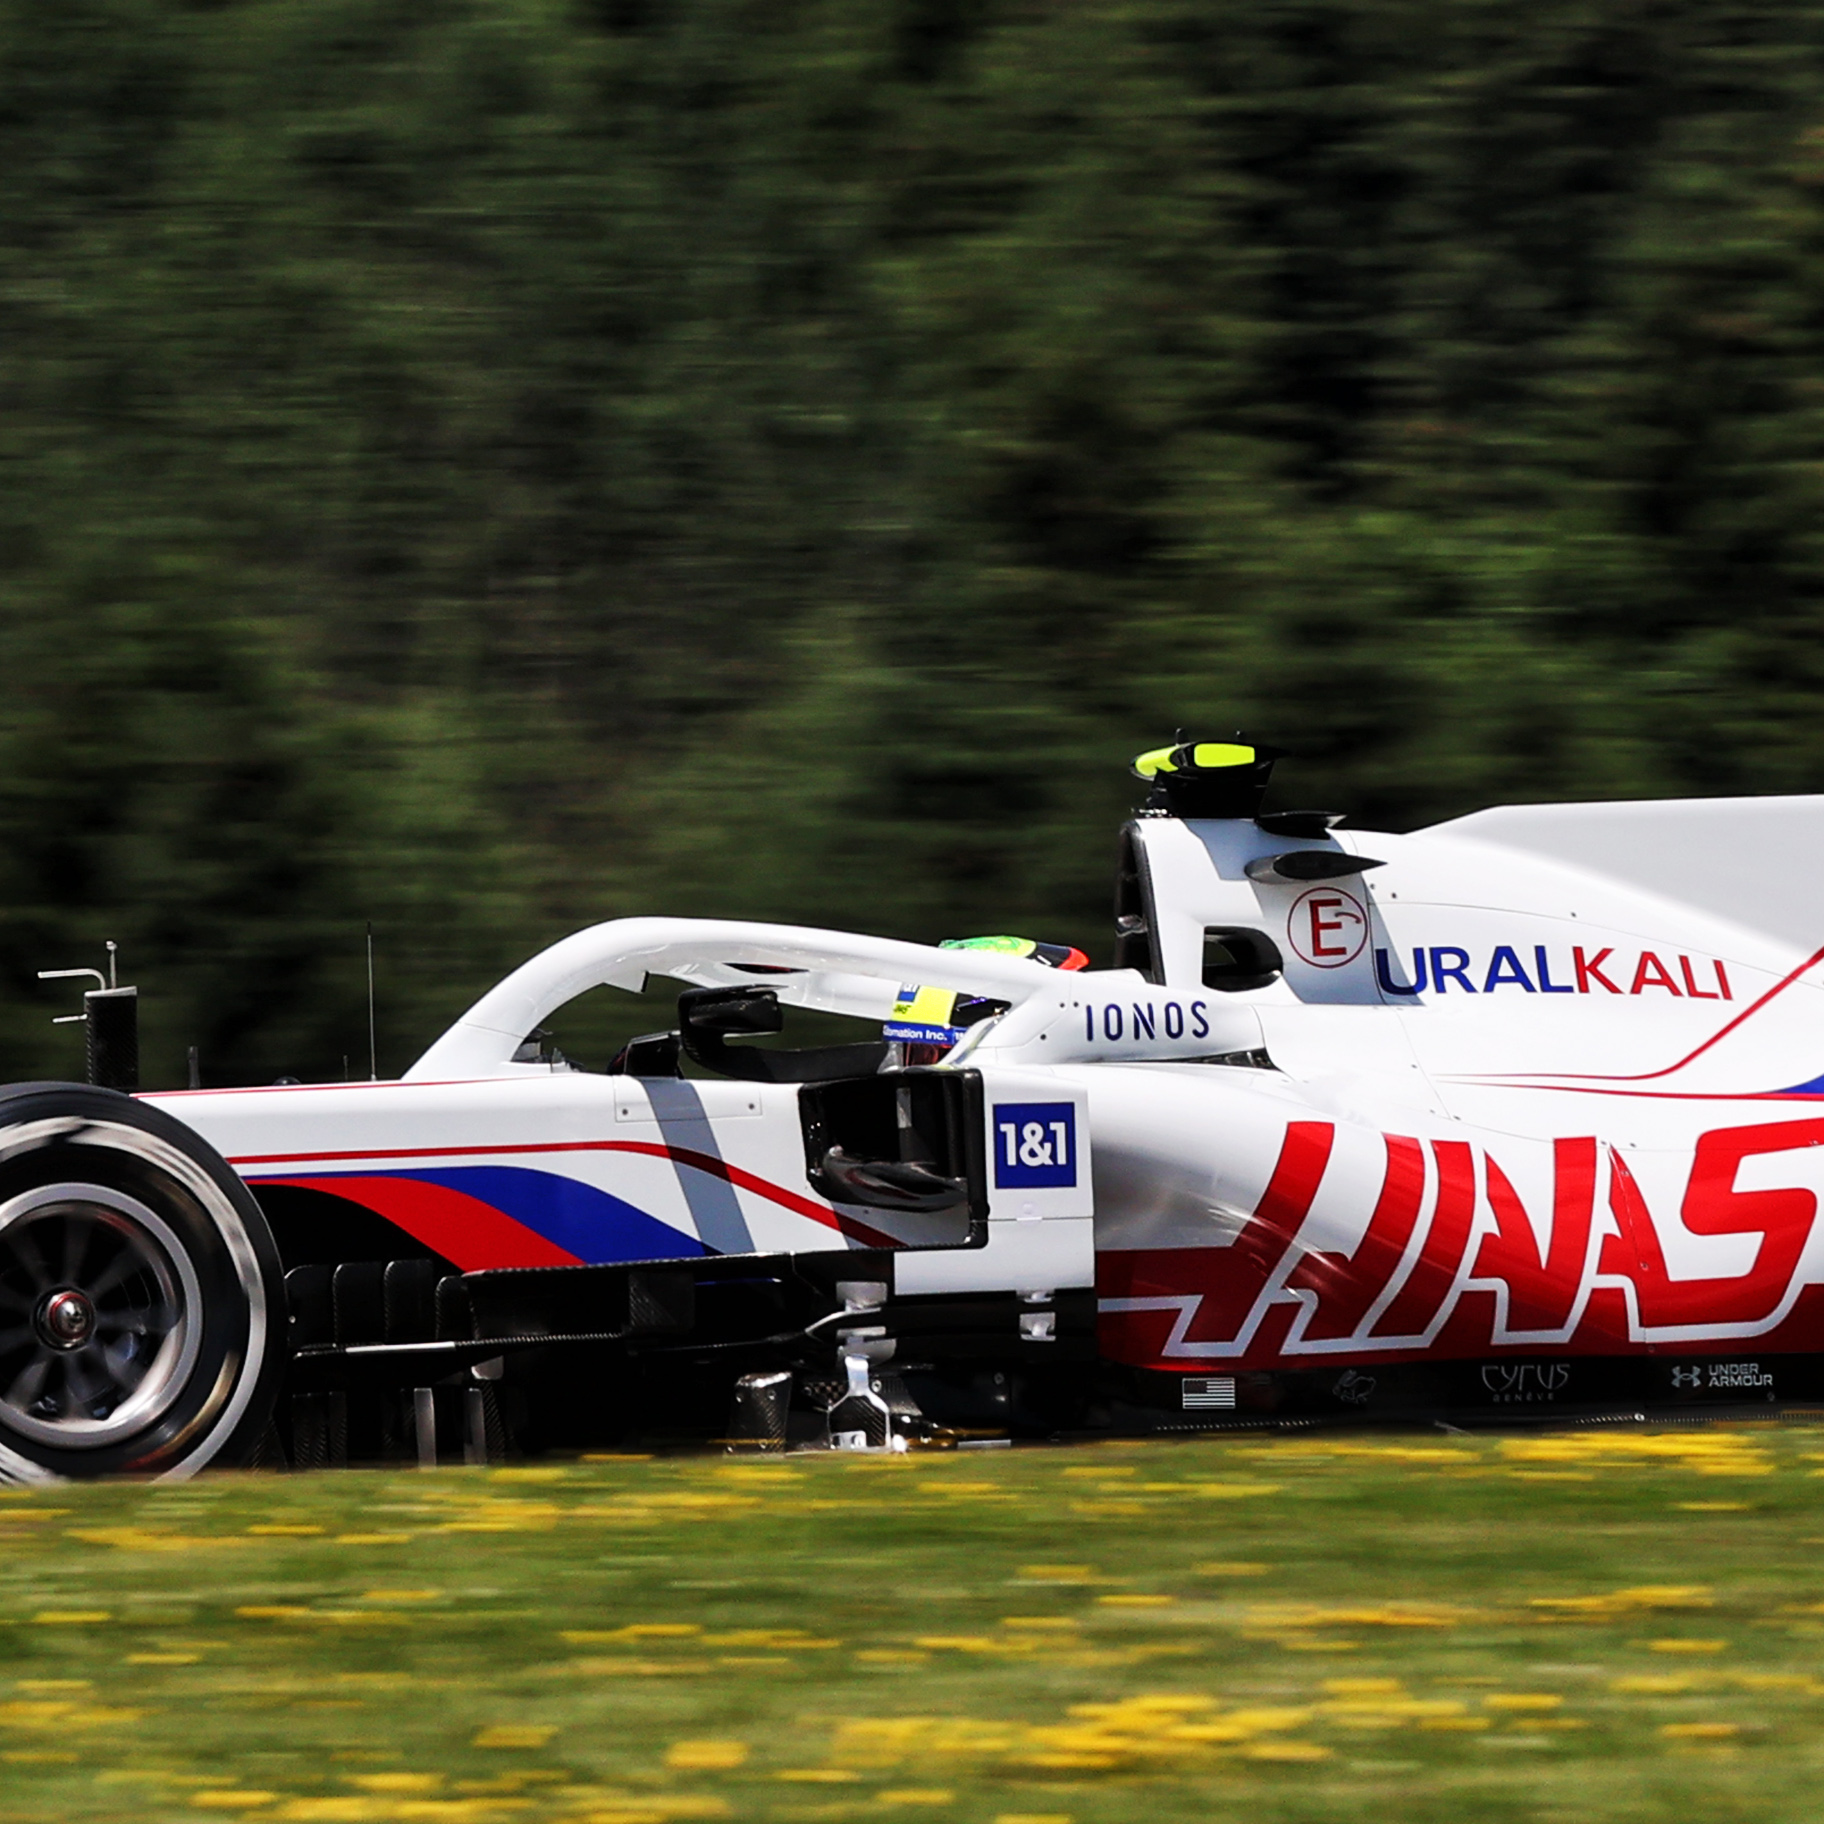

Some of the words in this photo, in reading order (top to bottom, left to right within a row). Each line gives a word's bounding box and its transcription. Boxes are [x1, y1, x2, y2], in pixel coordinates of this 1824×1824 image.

[1308, 898, 1348, 957] E
[1374, 945, 1734, 1001] URALKALI
[925, 1028, 948, 1041] Inc.
[1085, 1000, 1210, 1042] IONOS
[999, 1120, 1067, 1167] 1&1
[1708, 1363, 1760, 1376] UNDER
[1708, 1374, 1774, 1387] ARMOUR
